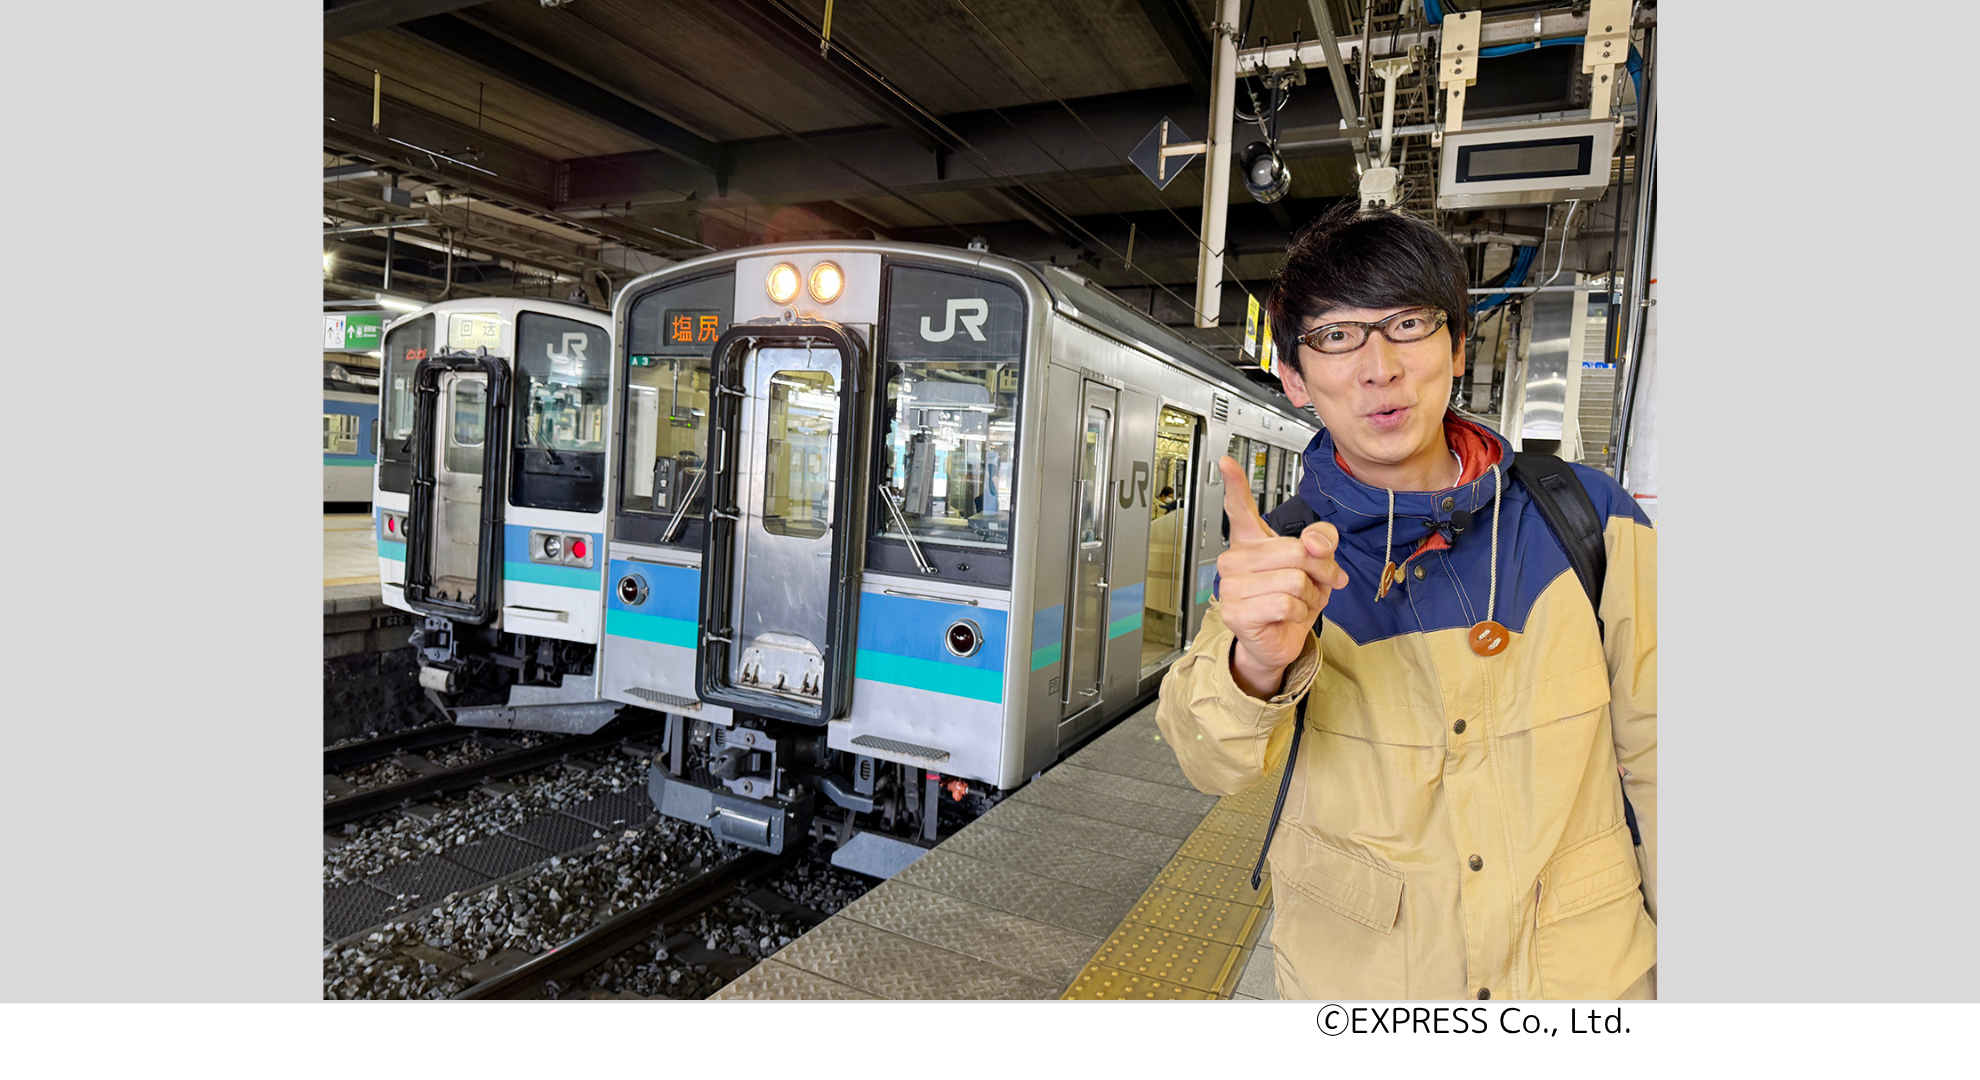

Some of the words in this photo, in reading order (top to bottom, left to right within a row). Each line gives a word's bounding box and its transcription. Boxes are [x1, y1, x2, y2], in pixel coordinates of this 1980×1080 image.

[460, 319, 496, 337] 回送
[671, 315, 719, 342] 塩尻
[920, 298, 989, 342] JR
[546, 332, 589, 363] JR
[1119, 461, 1149, 509] JR
